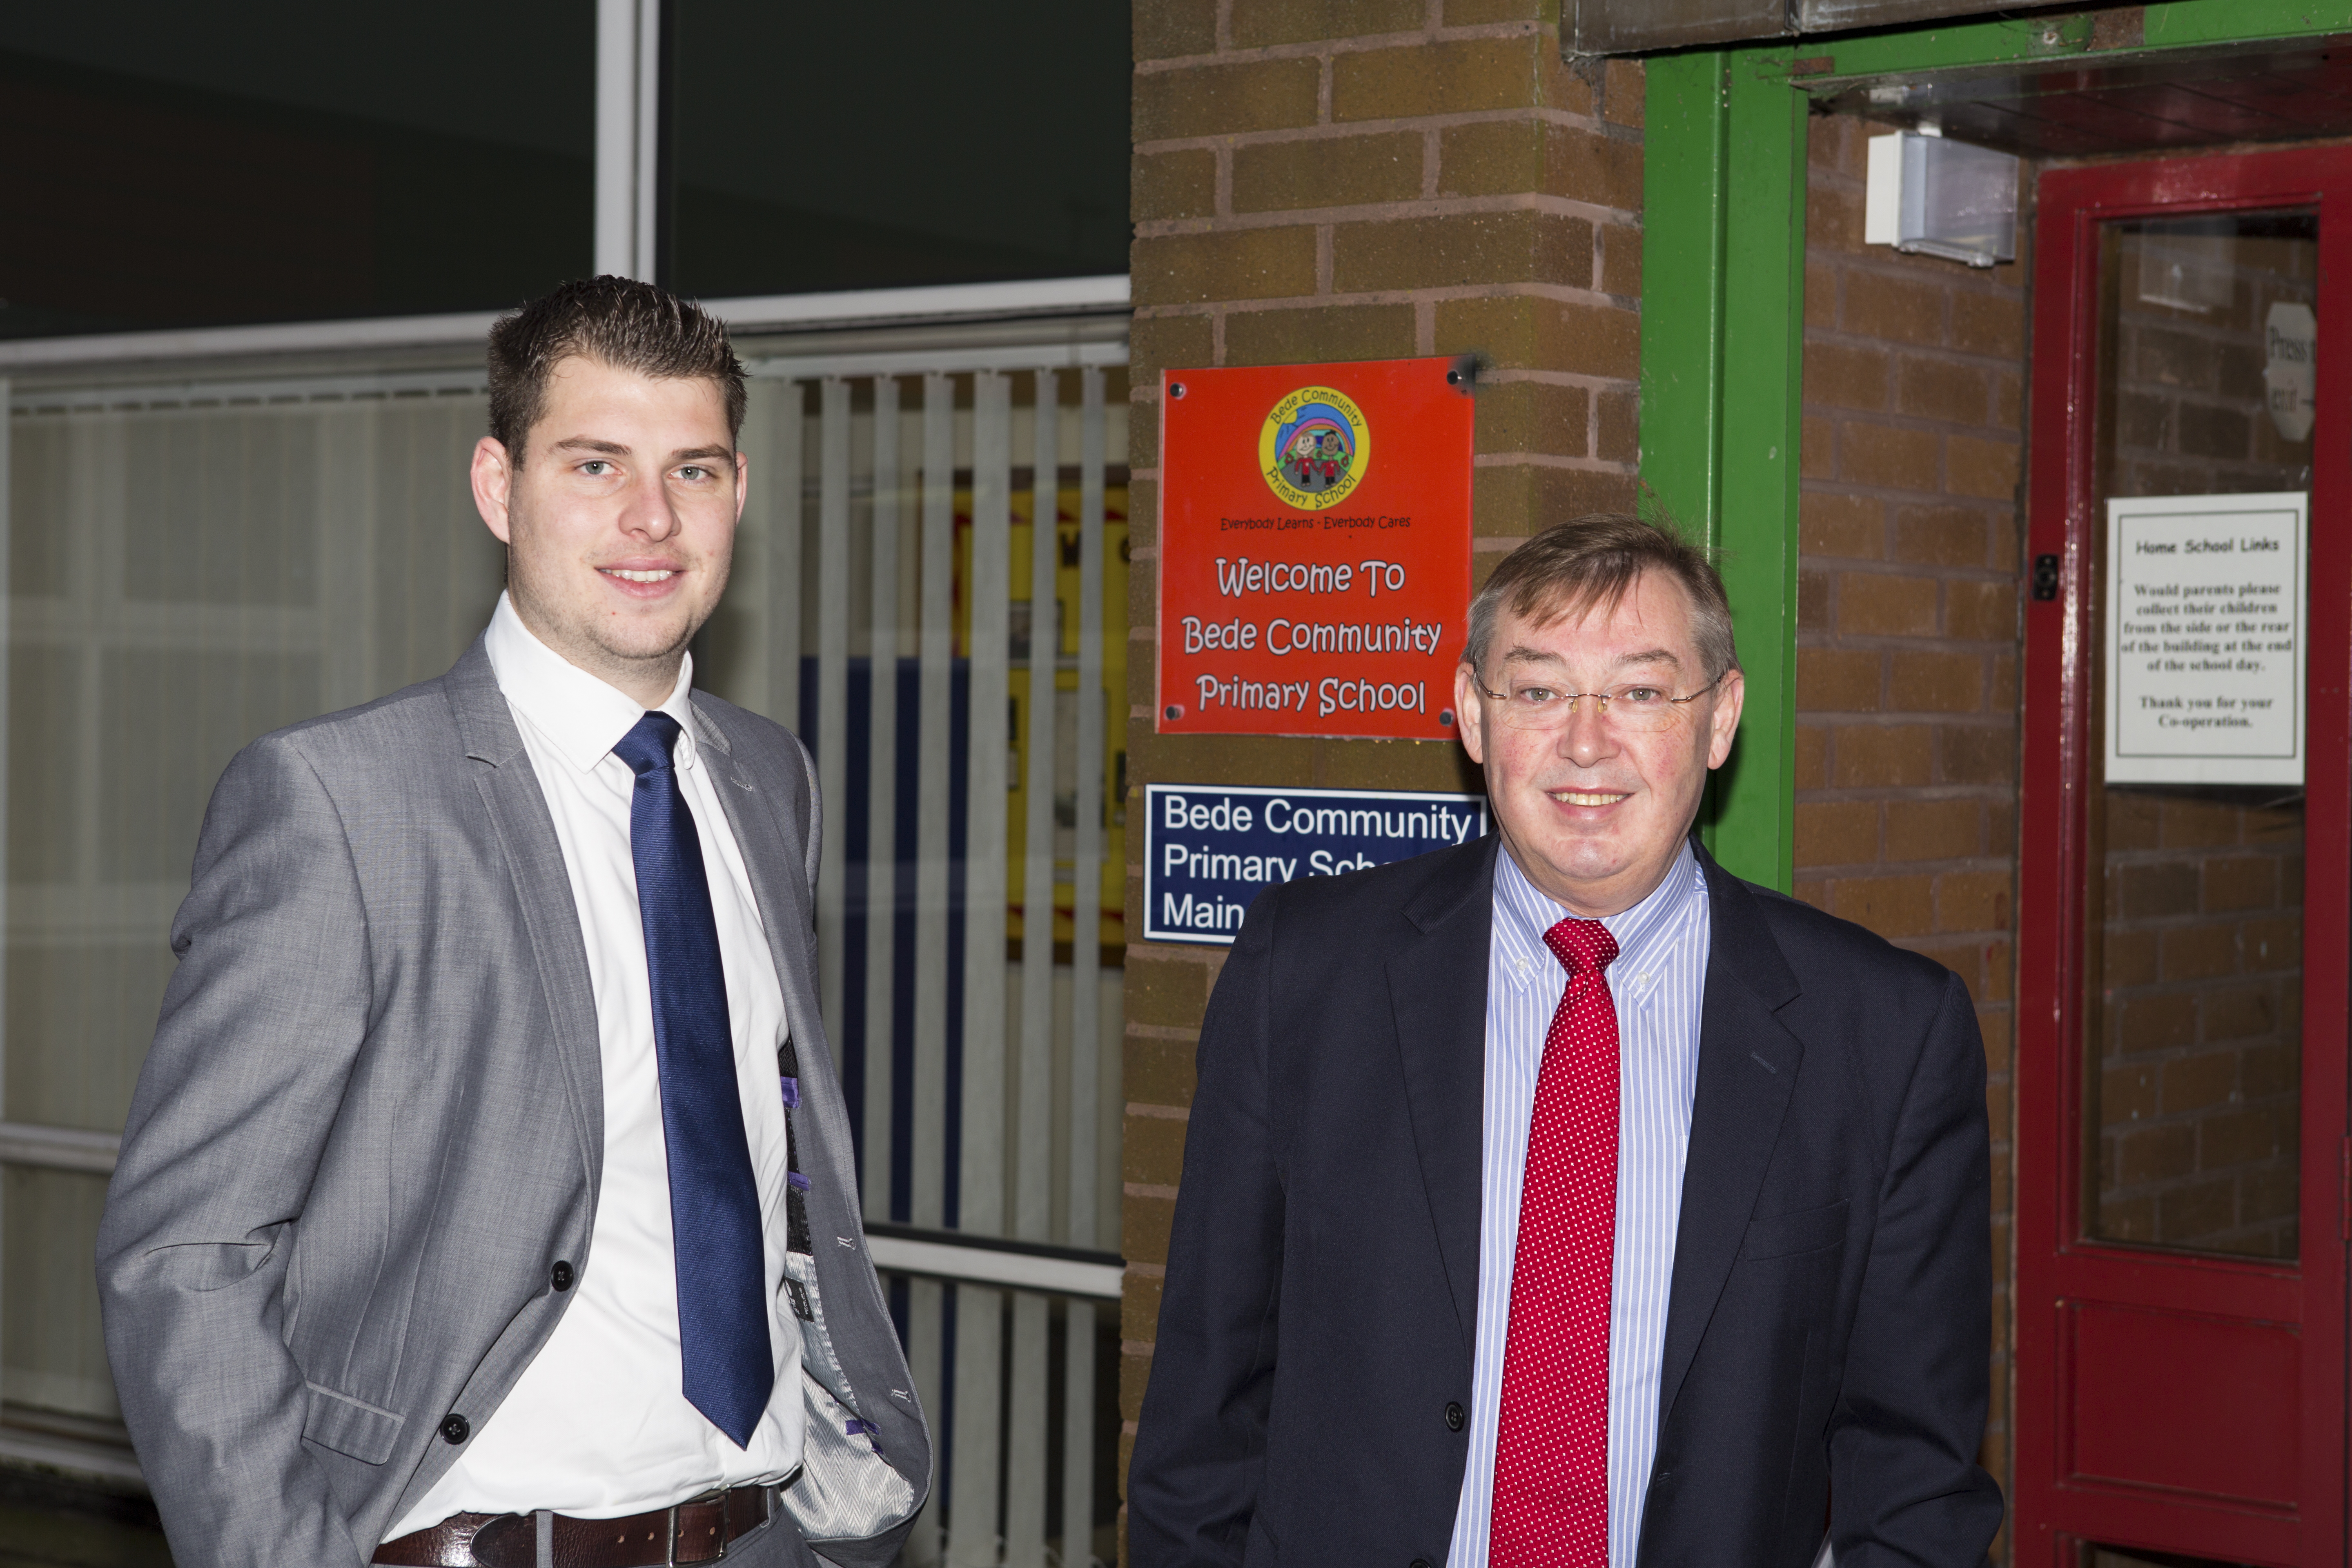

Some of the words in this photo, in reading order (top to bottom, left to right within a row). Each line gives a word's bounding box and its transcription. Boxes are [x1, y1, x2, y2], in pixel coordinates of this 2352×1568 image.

[2269, 325, 2307, 363] Press
[1270, 395, 1298, 425] Bede
[1301, 390, 1362, 427] Community
[1266, 466, 1308, 506] Primary
[1314, 474, 1356, 510] School
[1221, 518, 1274, 531] Everybody
[1277, 517, 1314, 530] Learns
[1324, 516, 1375, 529] Everbody
[1379, 516, 1410, 529] Cares
[2136, 540, 2176, 555] Home
[2184, 537, 2234, 554] School
[2241, 537, 2279, 552] Links
[1215, 557, 1353, 598] Welcome
[1359, 560, 1405, 597] To
[2134, 583, 2179, 596] Would
[2183, 584, 2234, 599] parents
[2238, 582, 2281, 598] please
[2137, 603, 2179, 615] collect
[2184, 602, 2215, 615] their
[2220, 601, 2277, 614] children
[1181, 616, 1258, 655] Bede
[1266, 617, 1442, 656] Community
[2124, 621, 2156, 634] from
[2161, 621, 2180, 633] the
[2186, 621, 2211, 633] side
[2216, 624, 2230, 633] or
[2236, 620, 2256, 633] the
[2261, 622, 2290, 633] rear
[2122, 640, 2135, 652] of
[2139, 640, 2158, 652] the
[2164, 639, 2220, 655] building
[2225, 641, 2237, 651] at
[2242, 639, 2262, 650] the
[2267, 639, 2292, 651] end
[2147, 659, 2161, 671] of
[2165, 659, 2184, 671] the
[2189, 658, 2232, 671] school
[2236, 658, 2265, 674] day.
[1196, 674, 1310, 712] Primary
[1318, 677, 1425, 718] School
[2140, 696, 2183, 709] Thank
[2188, 699, 2212, 712] you
[2217, 696, 2236, 708] for
[2241, 698, 2273, 712] your
[2158, 714, 2253, 731] Co-operation.
[1165, 795, 1252, 832] Bede
[1265, 799, 1472, 845] Community
[1165, 844, 1297, 883] Primary
[1164, 892, 1245, 929] Main
